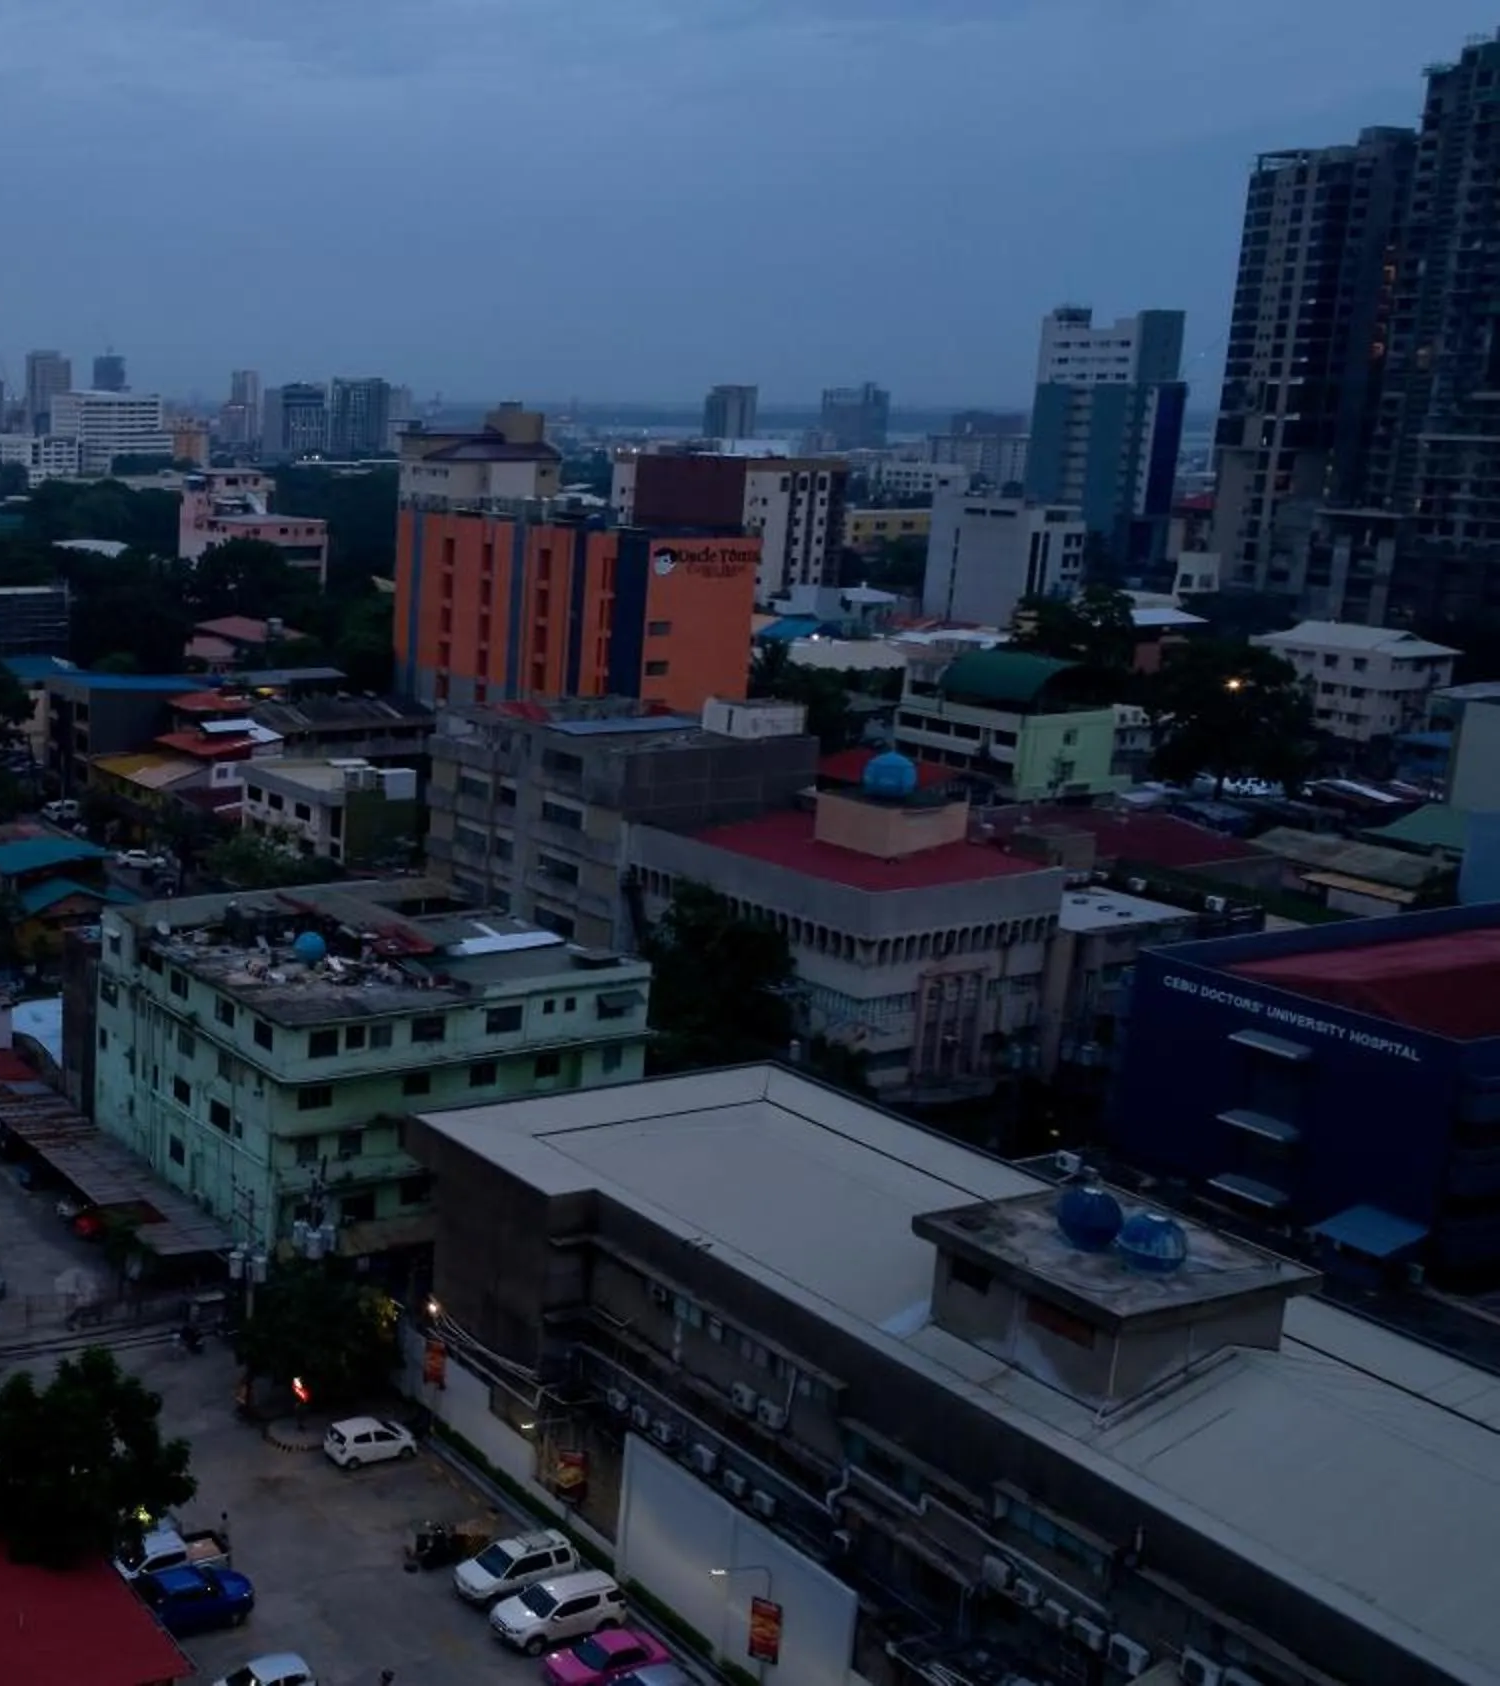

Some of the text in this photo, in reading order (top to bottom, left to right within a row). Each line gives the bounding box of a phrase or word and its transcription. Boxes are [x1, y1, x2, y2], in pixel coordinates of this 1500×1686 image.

[1163, 976, 1198, 994] CEBU
[1266, 1005, 1346, 1039] UNIVERSITY
[1350, 1029, 1421, 1062] HOSPITAL
